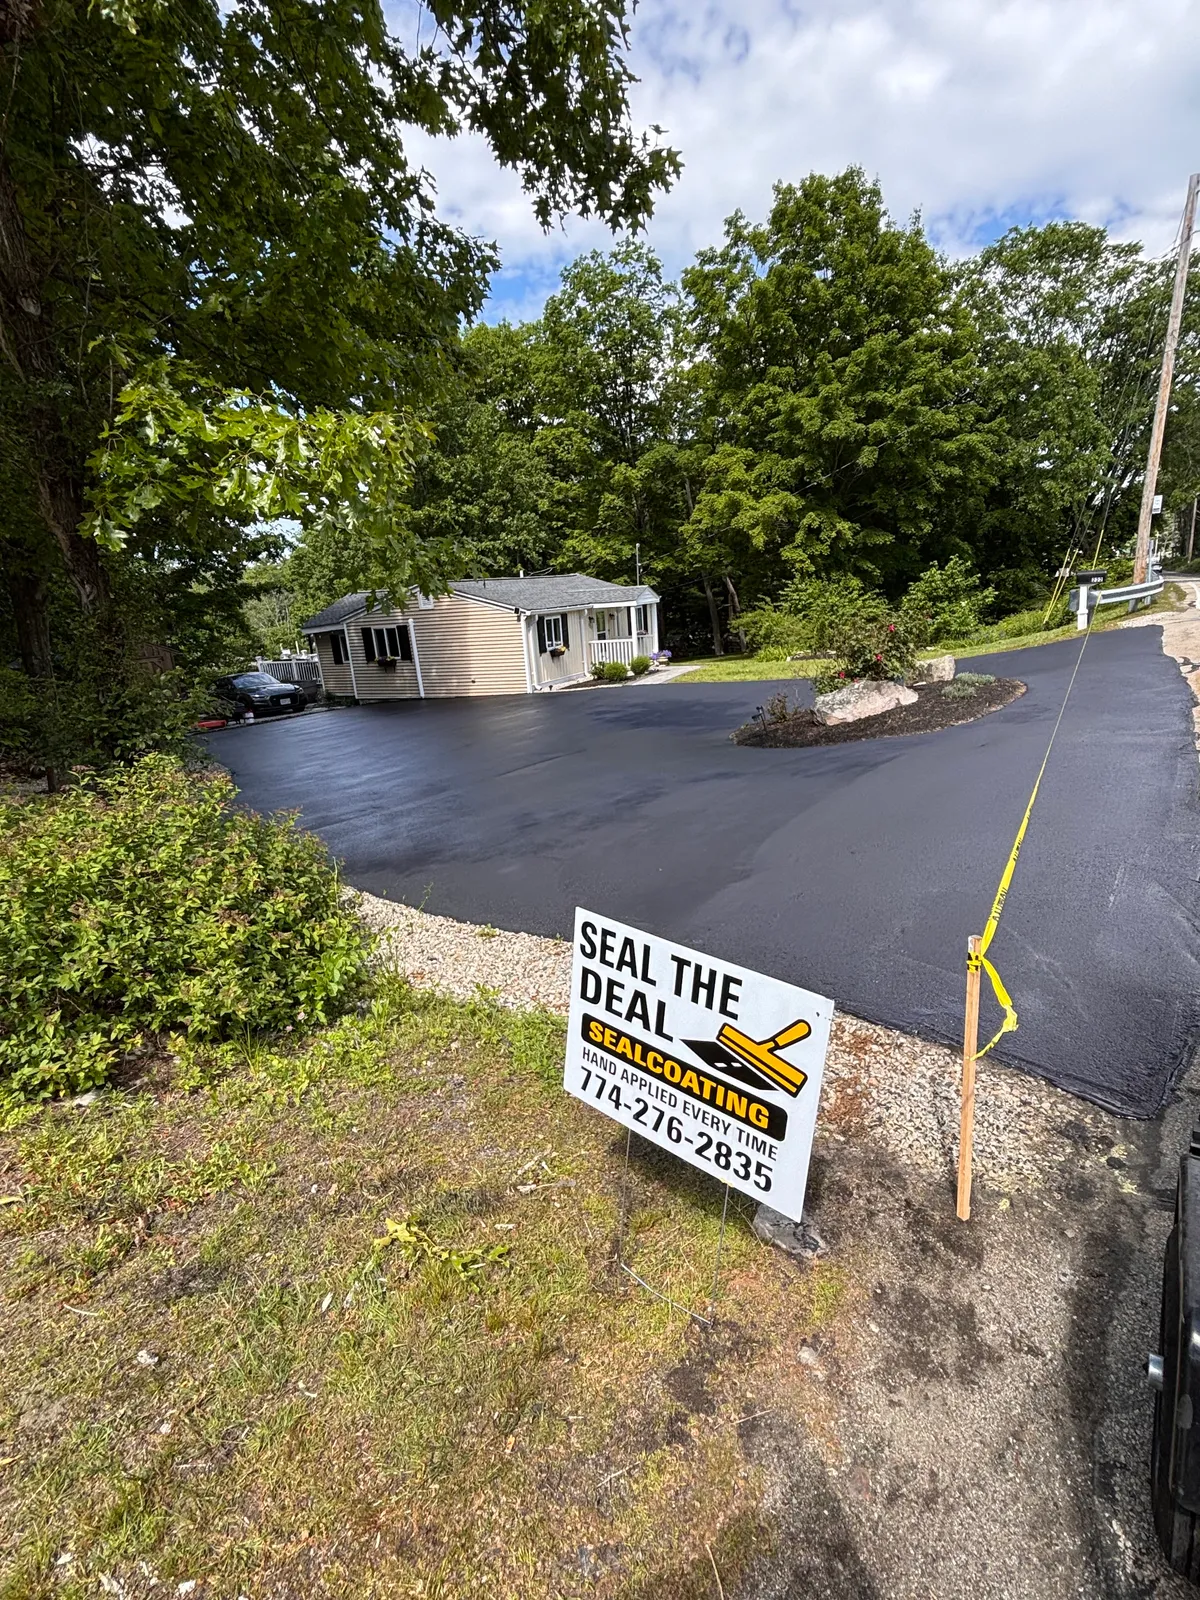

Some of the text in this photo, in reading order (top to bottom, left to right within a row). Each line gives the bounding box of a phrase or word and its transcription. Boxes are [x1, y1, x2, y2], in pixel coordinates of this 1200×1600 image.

[580, 921, 743, 1020] SEAL THE
[580, 966, 674, 1043] DEAL
[582, 1047, 778, 1162] HAND APPLIED EVERY TIME
[589, 1021, 770, 1129] SEALCOATING
[580, 1066, 773, 1193] 774-276-2835
